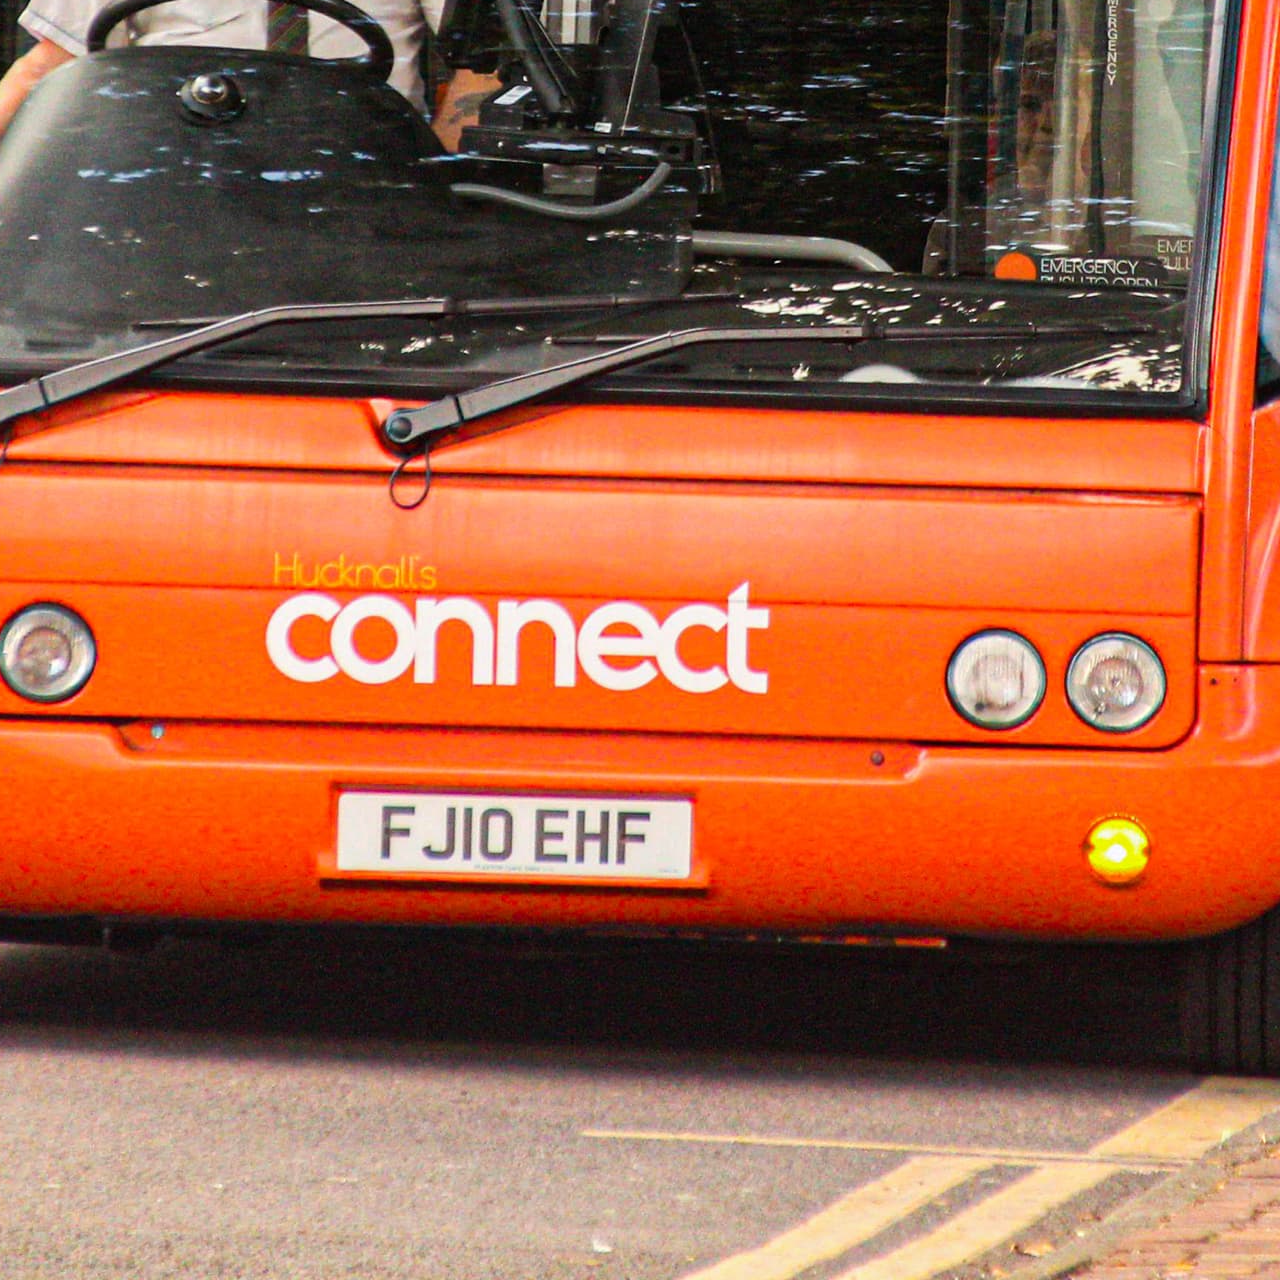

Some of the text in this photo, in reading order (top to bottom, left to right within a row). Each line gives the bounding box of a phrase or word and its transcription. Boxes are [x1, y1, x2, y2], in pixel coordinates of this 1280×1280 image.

[1040, 257, 1139, 275] EMERGENCY
[1157, 239, 1193, 254] EME
[273, 551, 438, 591] Hucknall's
[265, 580, 771, 695] connect
[380, 805, 652, 866] FJ10 EHF
